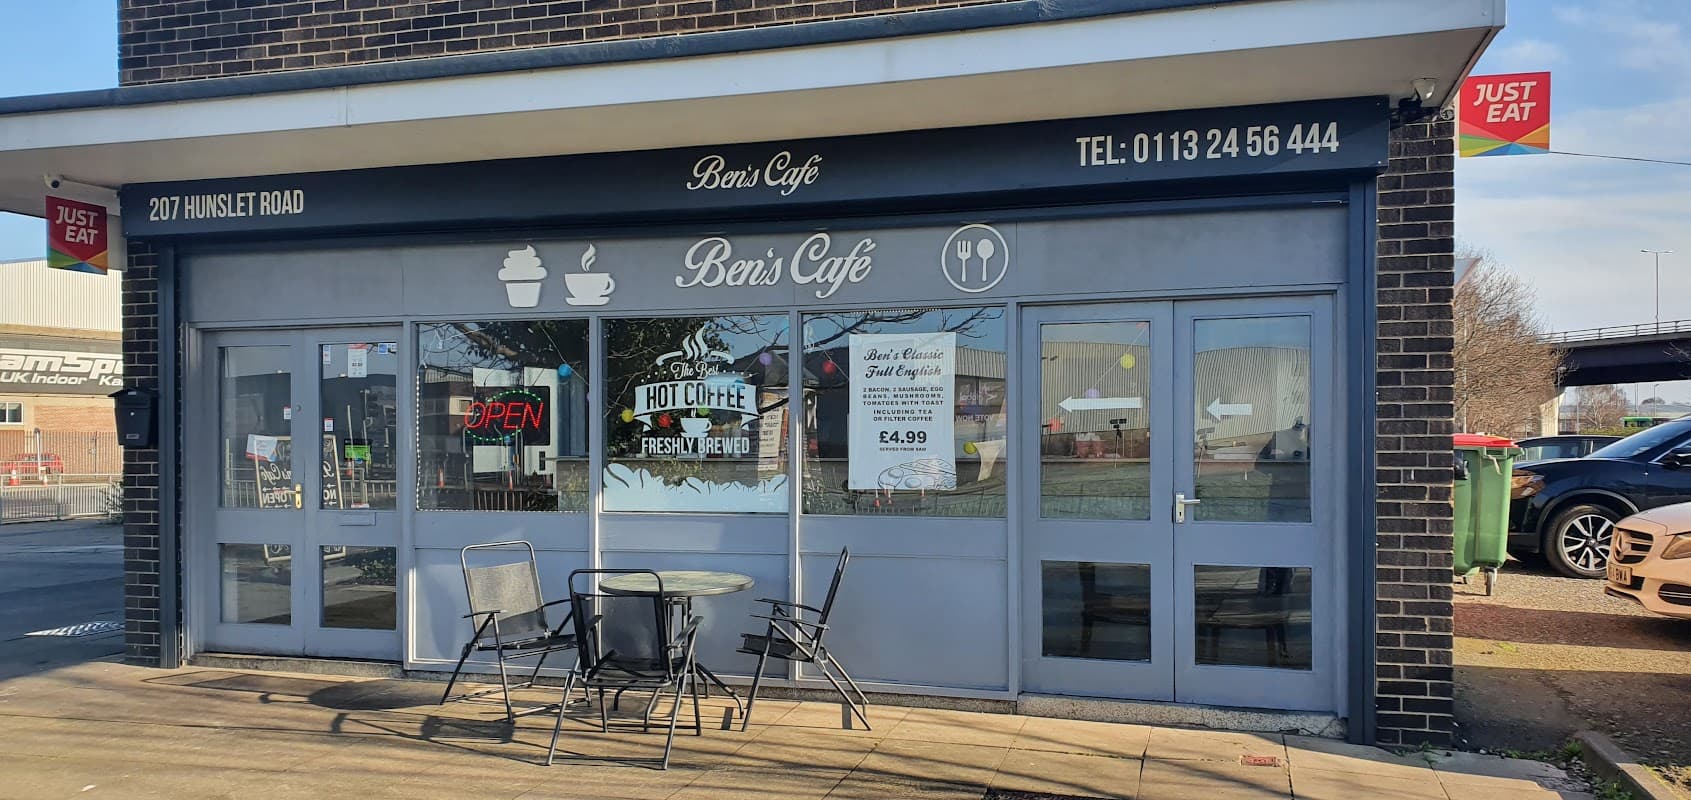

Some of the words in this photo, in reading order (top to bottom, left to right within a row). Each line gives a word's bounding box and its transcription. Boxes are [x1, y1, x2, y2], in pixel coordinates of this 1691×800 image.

[1473, 81, 1537, 106] JUST
[1486, 102, 1537, 122] EAT
[1076, 135, 1126, 166] TEL:
[1133, 130, 1198, 163] 0113
[1206, 128, 1239, 159] 24
[1247, 125, 1279, 157] 56
[1286, 122, 1339, 154] 444
[686, 155, 760, 190] Ben's
[764, 151, 823, 196] Café
[149, 196, 179, 221] 207
[184, 192, 256, 219] HUNSLET
[260, 189, 304, 216] ROAD
[56, 206, 99, 228] JUST
[65, 226, 98, 245] EAT
[675, 237, 784, 288] Ben's
[790, 232, 877, 299] Café
[863, 348, 899, 361] Ben's
[902, 347, 944, 360] Classic
[0, 371, 31, 384] UK
[31, 373, 88, 385] Indoor
[670, 361, 694, 379] The
[695, 361, 719, 379] Best
[865, 365, 894, 378] Full
[895, 364, 942, 380] English
[646, 384, 679, 410] HOT
[684, 382, 746, 410] COFFEE
[464, 402, 545, 429] OPEN
[641, 437, 695, 454] FRESHLY
[697, 437, 750, 454] BREWED
[879, 430, 927, 443] £4.99
